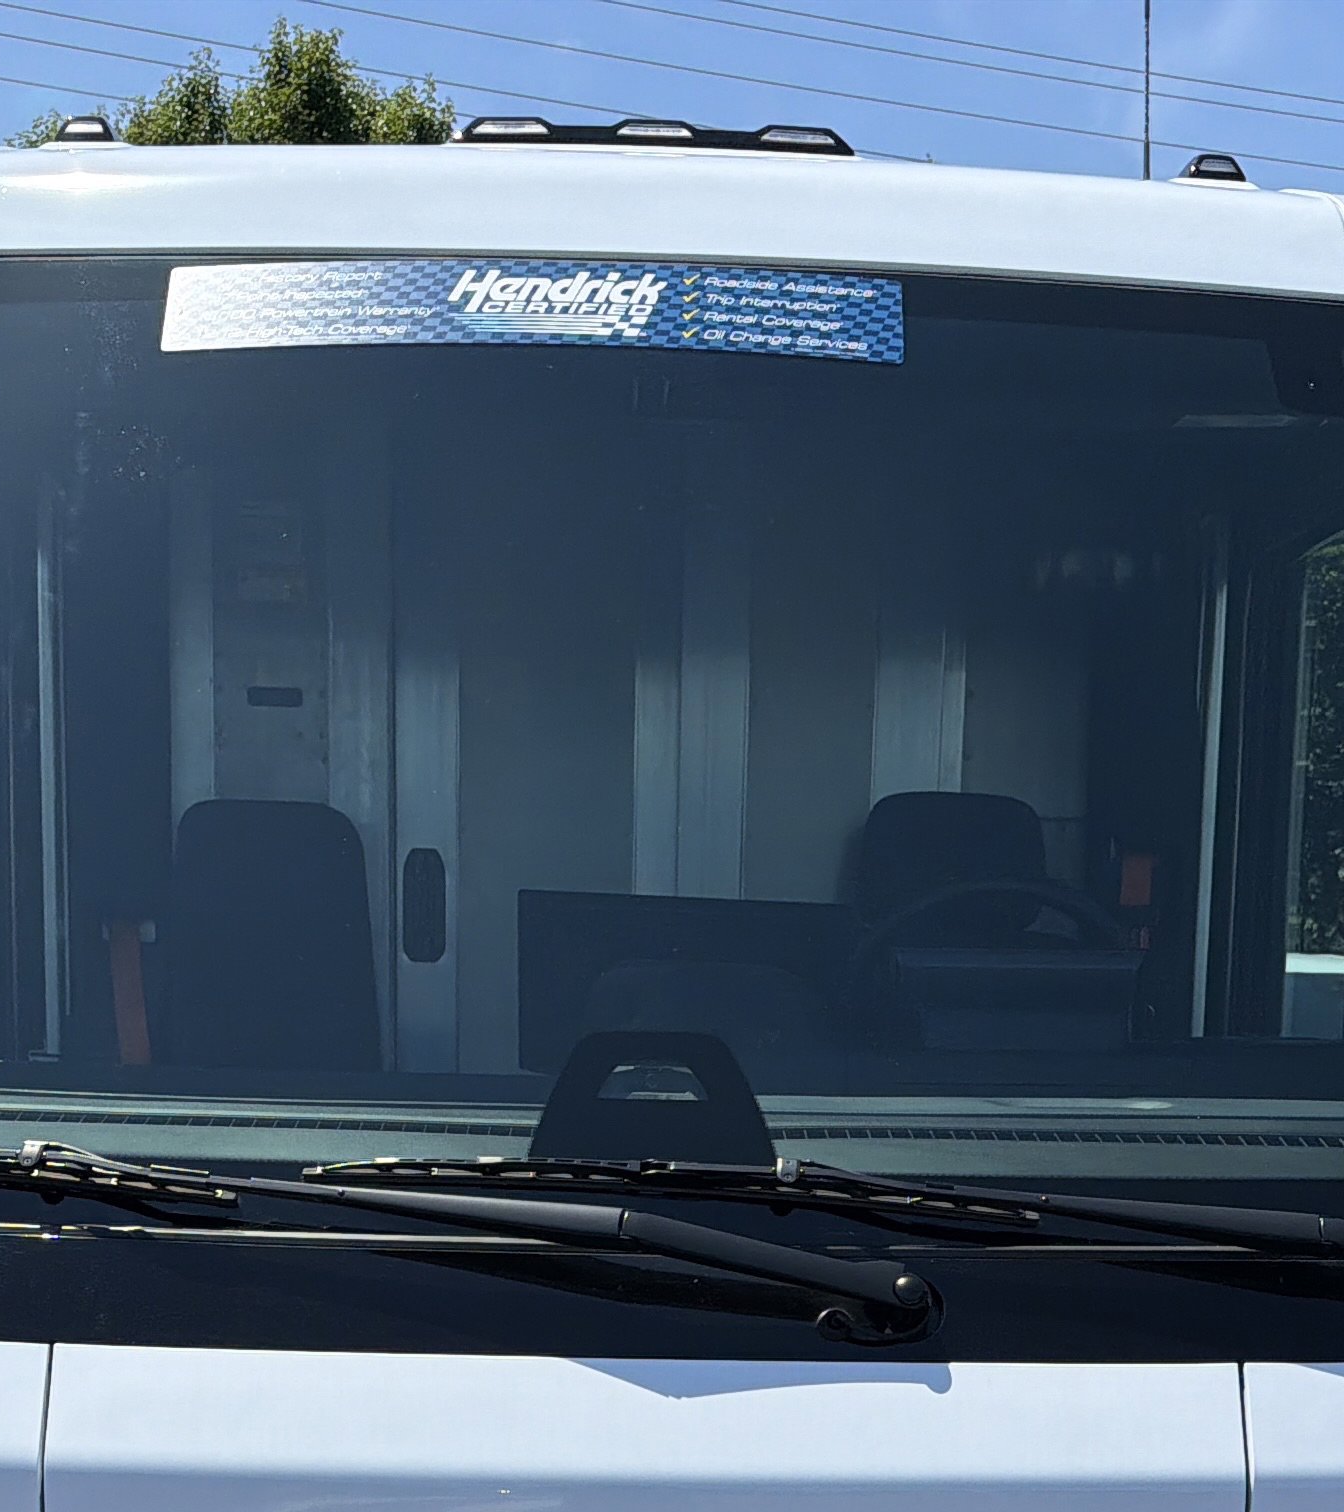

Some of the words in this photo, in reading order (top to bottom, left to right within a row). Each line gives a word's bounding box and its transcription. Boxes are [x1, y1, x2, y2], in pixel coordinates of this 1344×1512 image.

[323, 271, 383, 282] Report
[704, 276, 778, 291] Roadside
[447, 269, 668, 313] Hendrick
[705, 293, 735, 306] Trip
[260, 305, 352, 318] Powertrain
[481, 301, 654, 316] CERTIFIED
[704, 311, 757, 324] Rental
[703, 329, 726, 340] Oil
[729, 331, 792, 346] Change
[796, 335, 868, 351] Services
